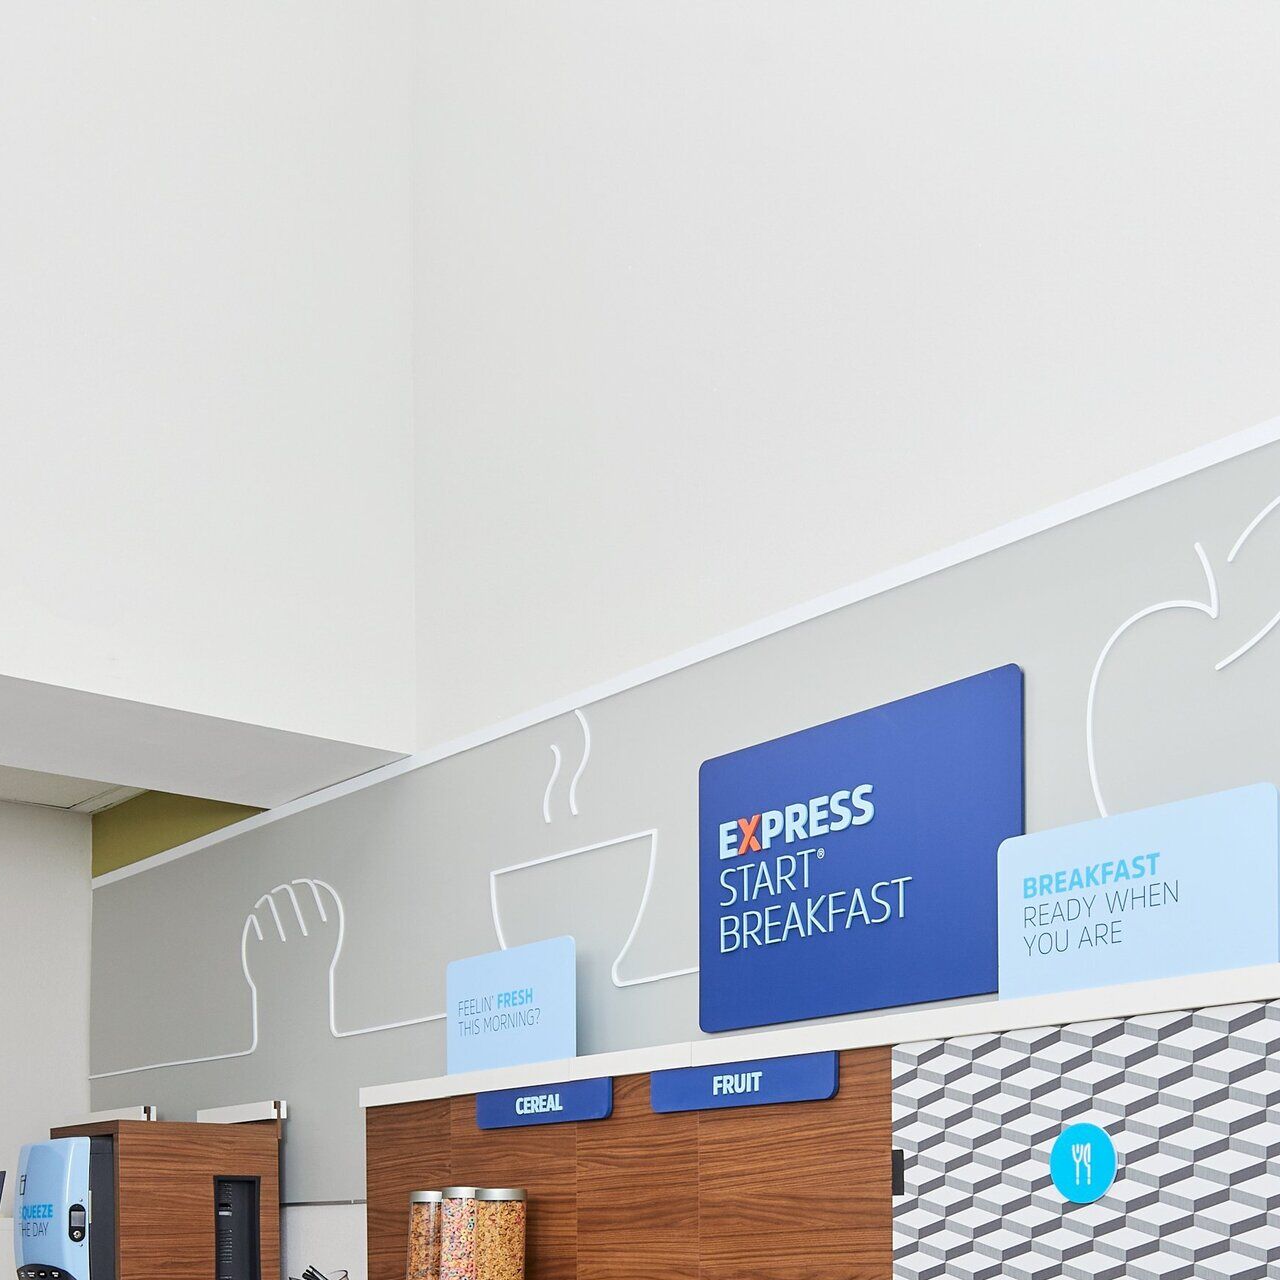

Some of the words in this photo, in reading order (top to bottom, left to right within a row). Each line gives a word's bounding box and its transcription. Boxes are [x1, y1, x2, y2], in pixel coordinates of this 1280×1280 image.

[719, 783, 875, 860] EXPRESS
[1023, 852, 1160, 899] BREAKFAST
[720, 876, 913, 954] BREAKFAST
[1024, 894, 1096, 928] READY
[1105, 880, 1179, 914] WHEN
[1023, 929, 1069, 956] YOU
[1078, 920, 1122, 949] ARE
[458, 995, 494, 1017] FEELIN'
[497, 987, 533, 1010] FRESH
[458, 1018, 480, 1037] THIS
[483, 1007, 541, 1032] MORNING?
[712, 1071, 763, 1096] FRUIT
[515, 1093, 563, 1115] CEREAL
[19, 1222, 31, 1237] HE
[33, 1222, 49, 1237] DAY
